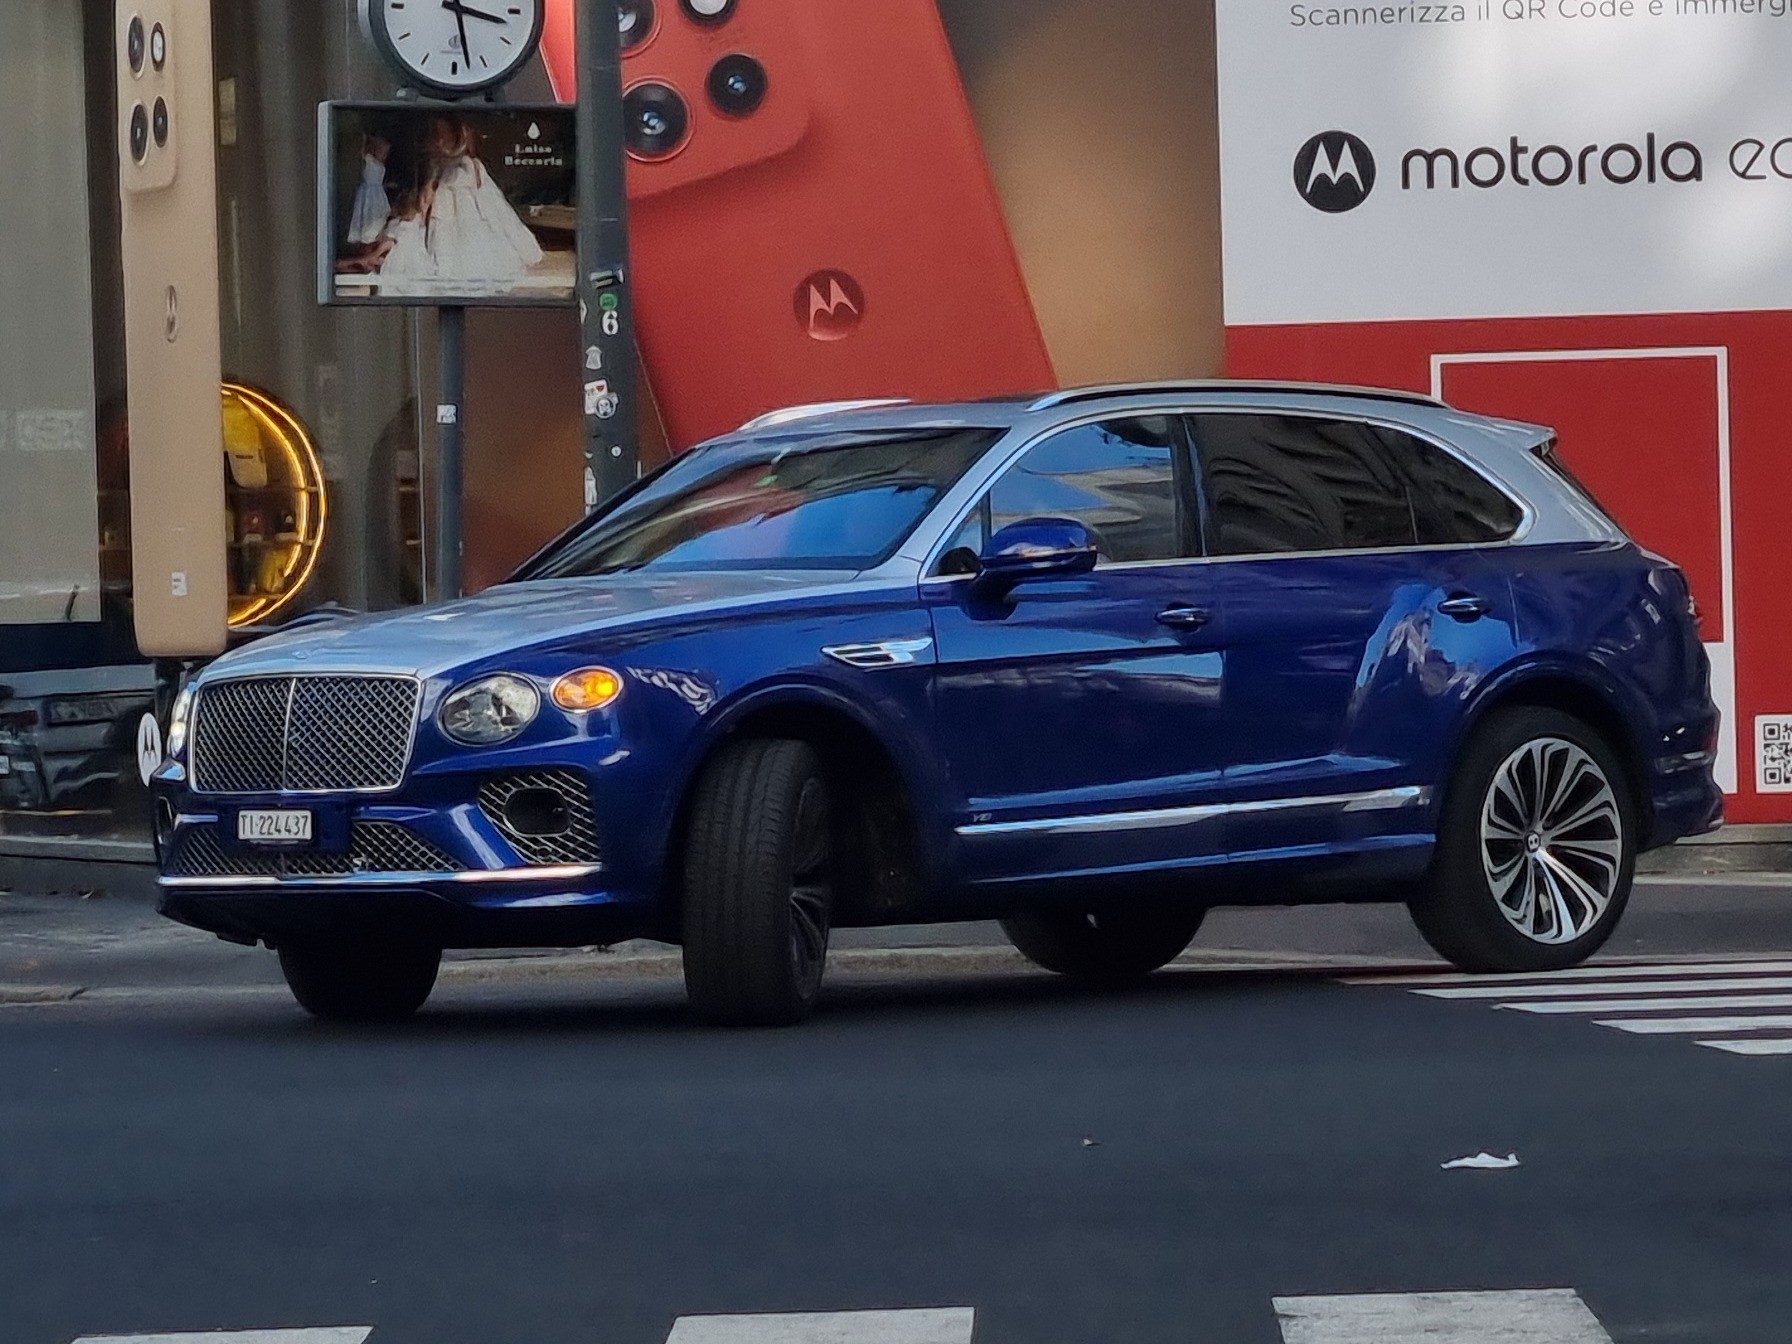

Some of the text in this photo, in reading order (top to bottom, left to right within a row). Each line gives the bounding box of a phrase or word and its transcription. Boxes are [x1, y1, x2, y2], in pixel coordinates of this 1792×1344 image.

[1290, 1, 1465, 27] Scannerizza
[1478, 0, 1489, 21] il
[1502, 0, 1546, 20] QR
[1558, 0, 1634, 18] Code
[1648, 0, 1663, 16] e
[1401, 132, 1703, 190] motorola
[602, 310, 619, 336] 6
